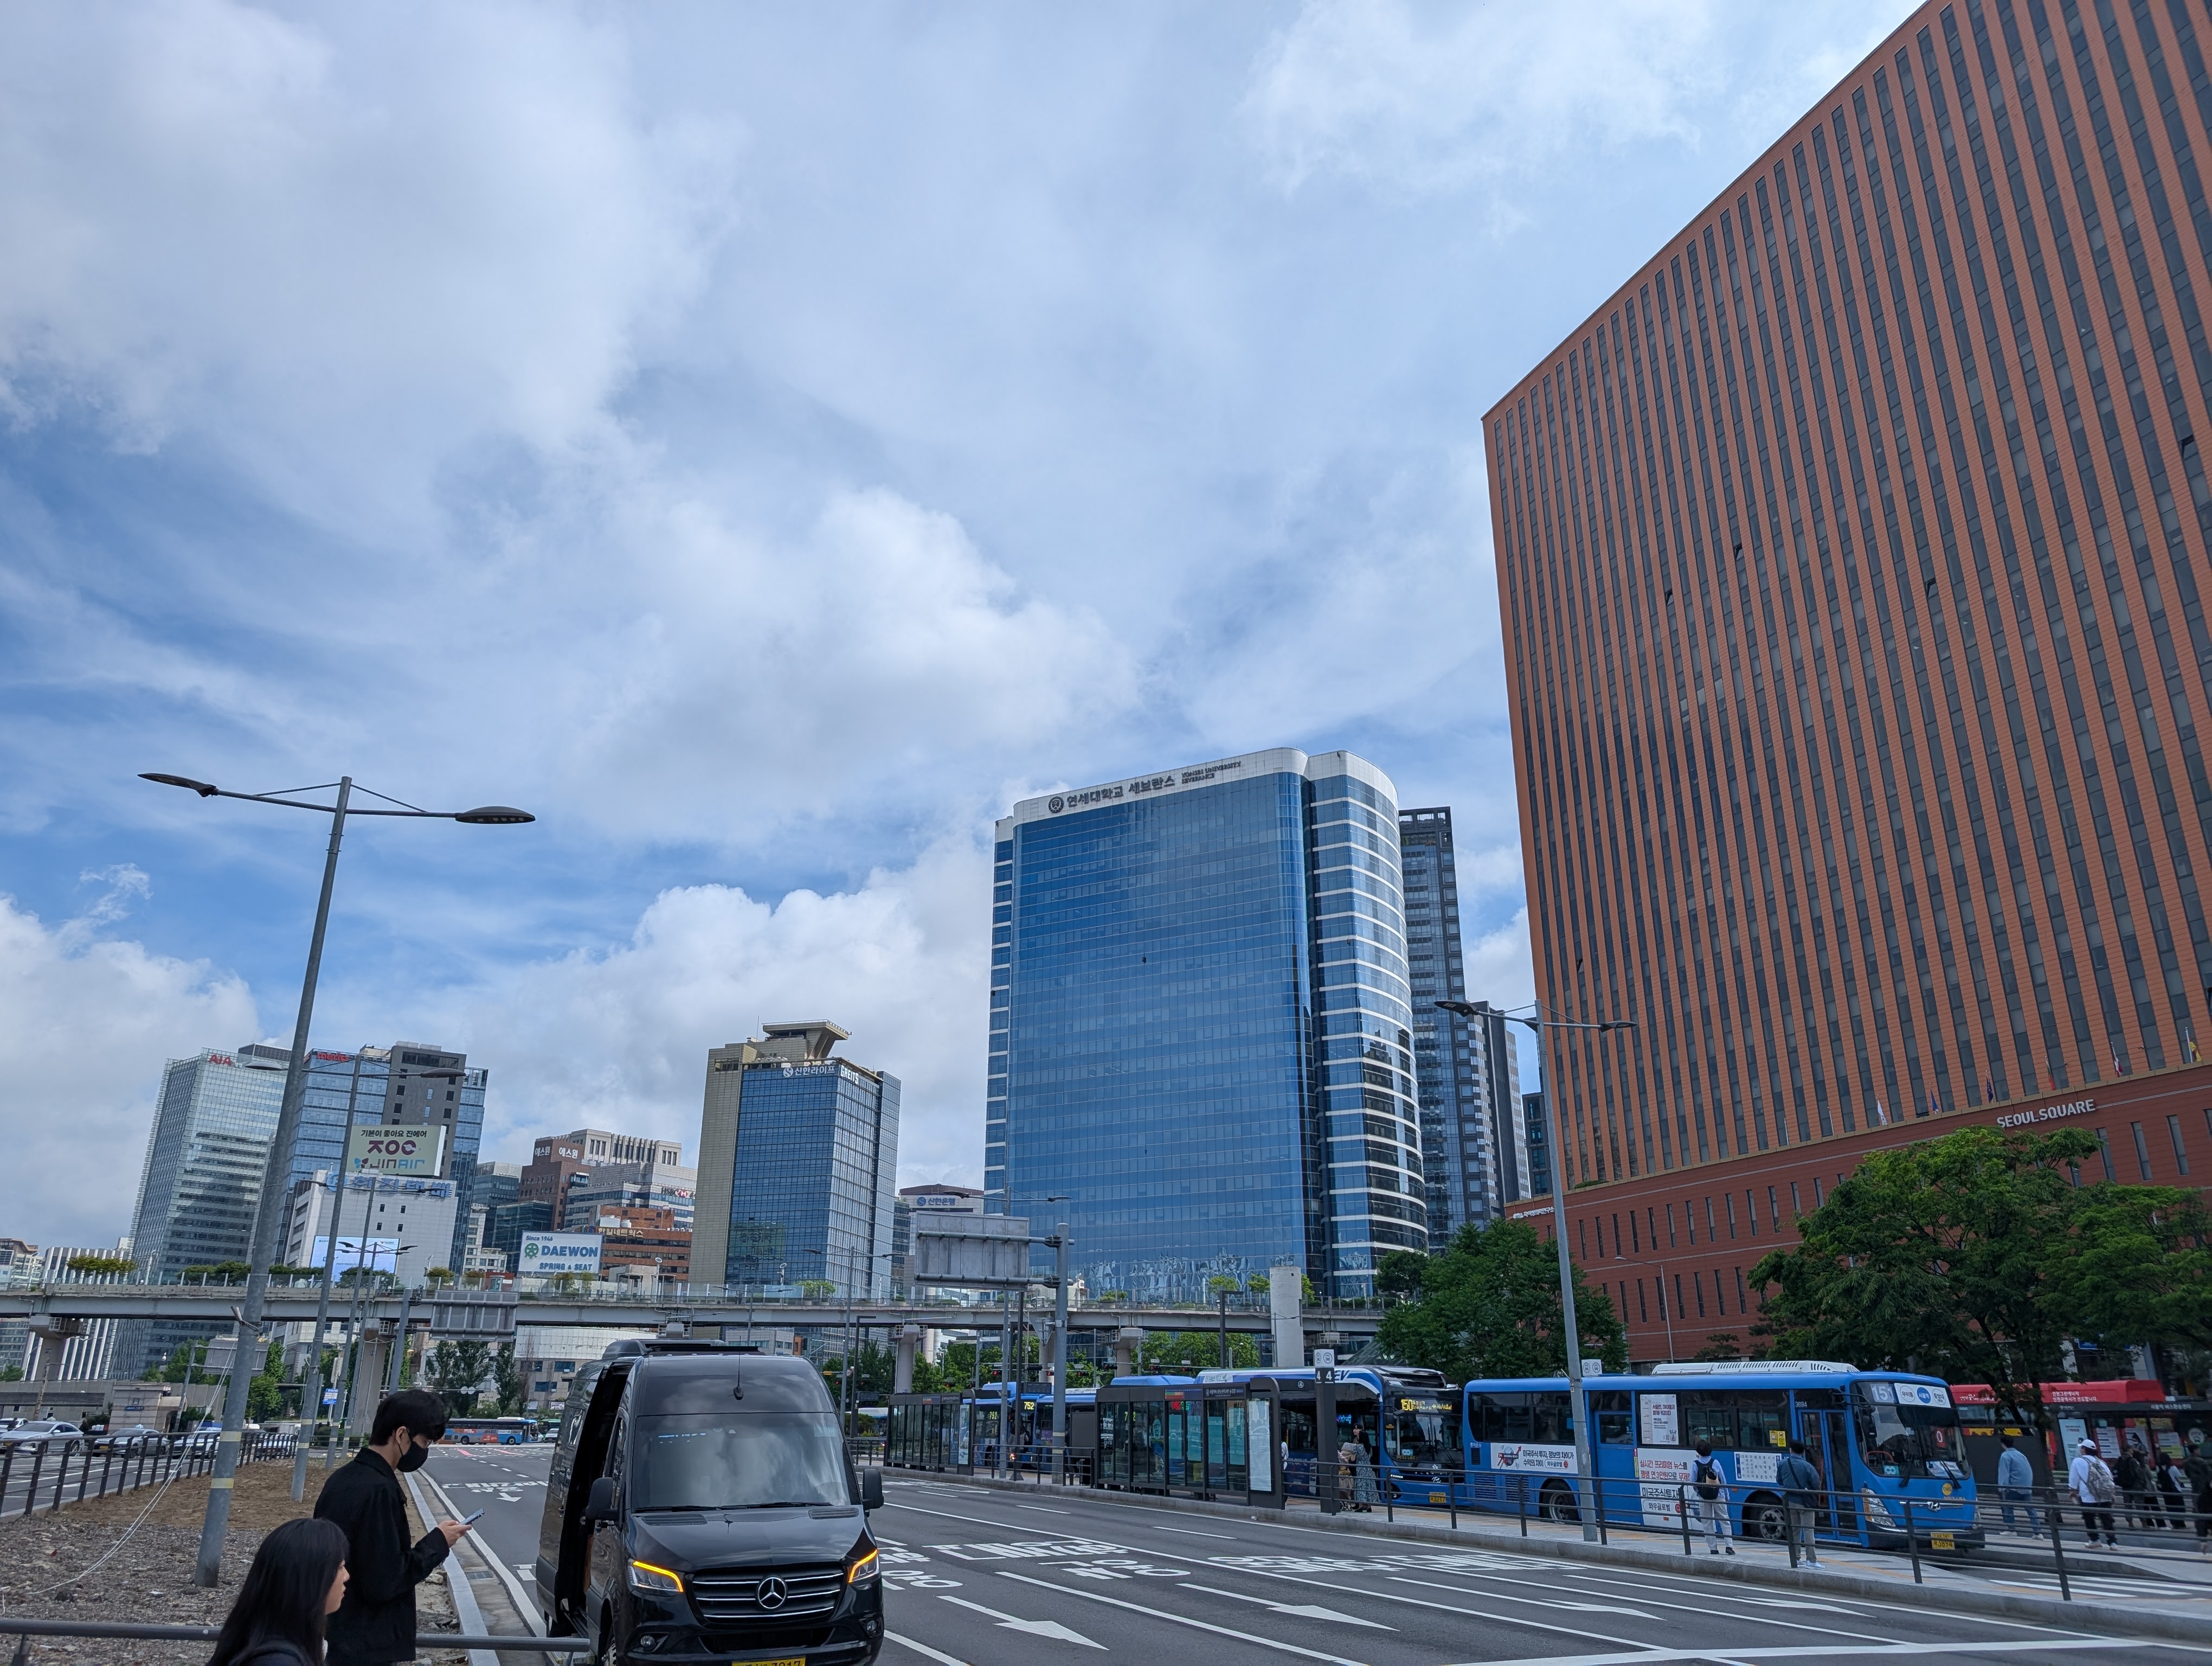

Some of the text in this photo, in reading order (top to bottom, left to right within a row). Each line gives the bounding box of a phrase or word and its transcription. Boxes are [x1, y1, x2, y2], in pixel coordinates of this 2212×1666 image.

[1181, 761, 1241, 778] YONSEI UNIVERSITY
[1181, 773, 1215, 784] SEVERANCE
[1067, 776, 1175, 807] 연세대학교 세브란스
[209, 1054, 232, 1066] AIA
[794, 1066, 835, 1076] 신한라이프
[841, 1065, 859, 1084] GREITS
[1997, 1099, 2096, 1129] SEOUL SQUARE
[535, 1145, 551, 1156] 에스원
[558, 1146, 578, 1159] 에스원
[661, 1187, 680, 1196] HSBC
[928, 1197, 956, 1206] 신한은행
[598, 1227, 644, 1238] 한일네트웍스
[541, 1245, 599, 1257] DAEWON
[539, 1262, 565, 1271] SPRING
[1316, 1370, 1321, 1381] 4
[1326, 1370, 1333, 1381] 4
[1872, 1385, 1895, 1401] 151
[1024, 1401, 1034, 1410] 752
[989, 1411, 998, 1419] 752
[1640, 1459, 1654, 1468] 실시간
[1654, 1460, 1673, 1469] 프리미엄
[1673, 1461, 1688, 1470] 뉴스를
[1641, 1470, 1650, 1479] 평생
[1642, 1487, 1680, 1499] 미국주식투자
[1648, 1502, 1671, 1512] 와우글로벌
[922, 1540, 1129, 1560] 한강대교
[1038, 1559, 1191, 1579] 용산
